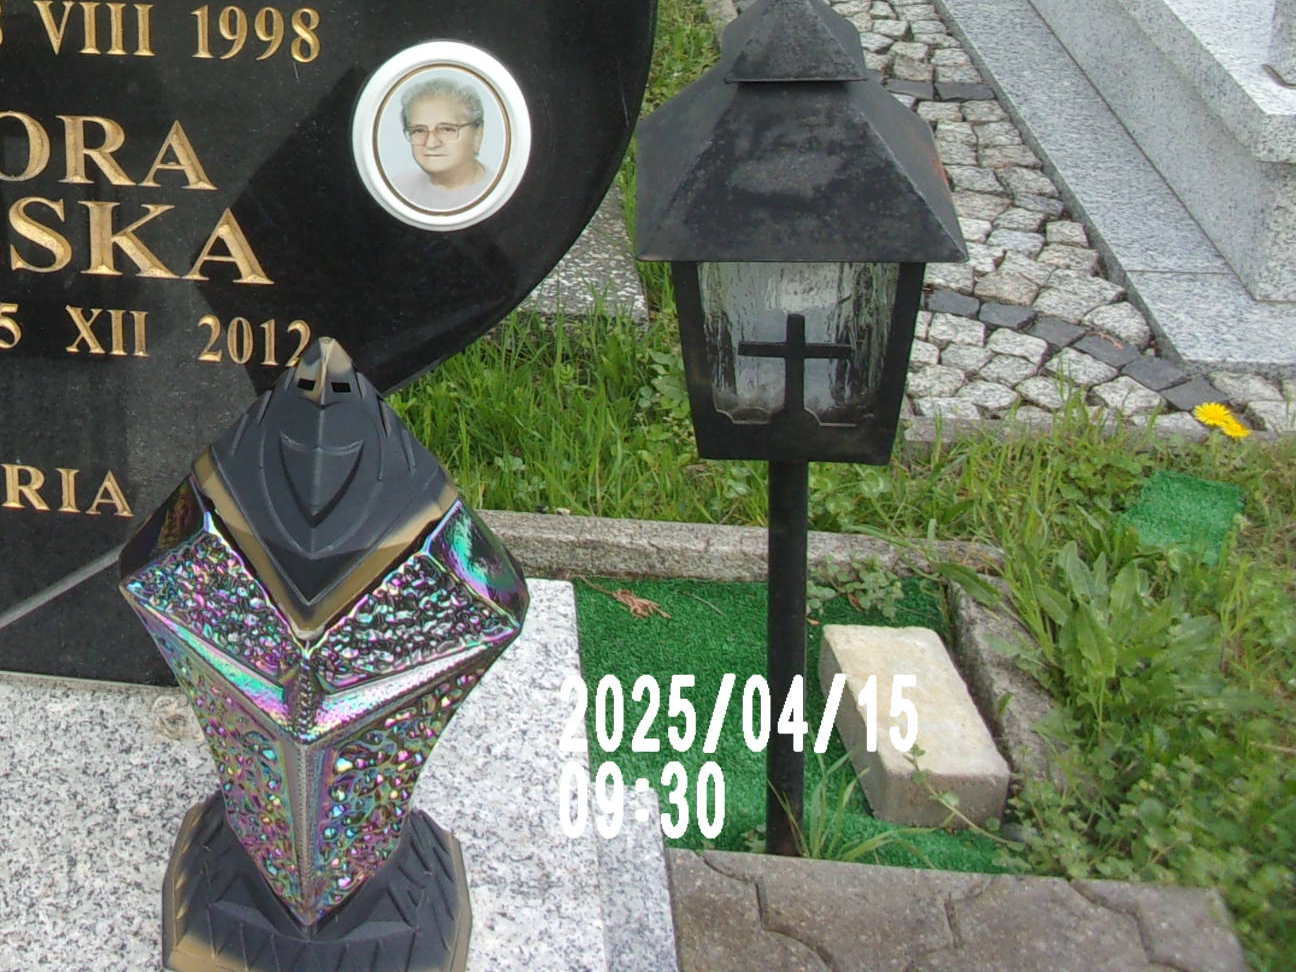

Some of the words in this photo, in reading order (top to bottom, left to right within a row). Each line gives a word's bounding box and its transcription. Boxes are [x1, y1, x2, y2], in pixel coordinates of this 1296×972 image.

[33, 0, 156, 55] VIII
[190, 3, 321, 63] 1998
[64, 304, 149, 357] XII
[196, 313, 311, 368] 2012
